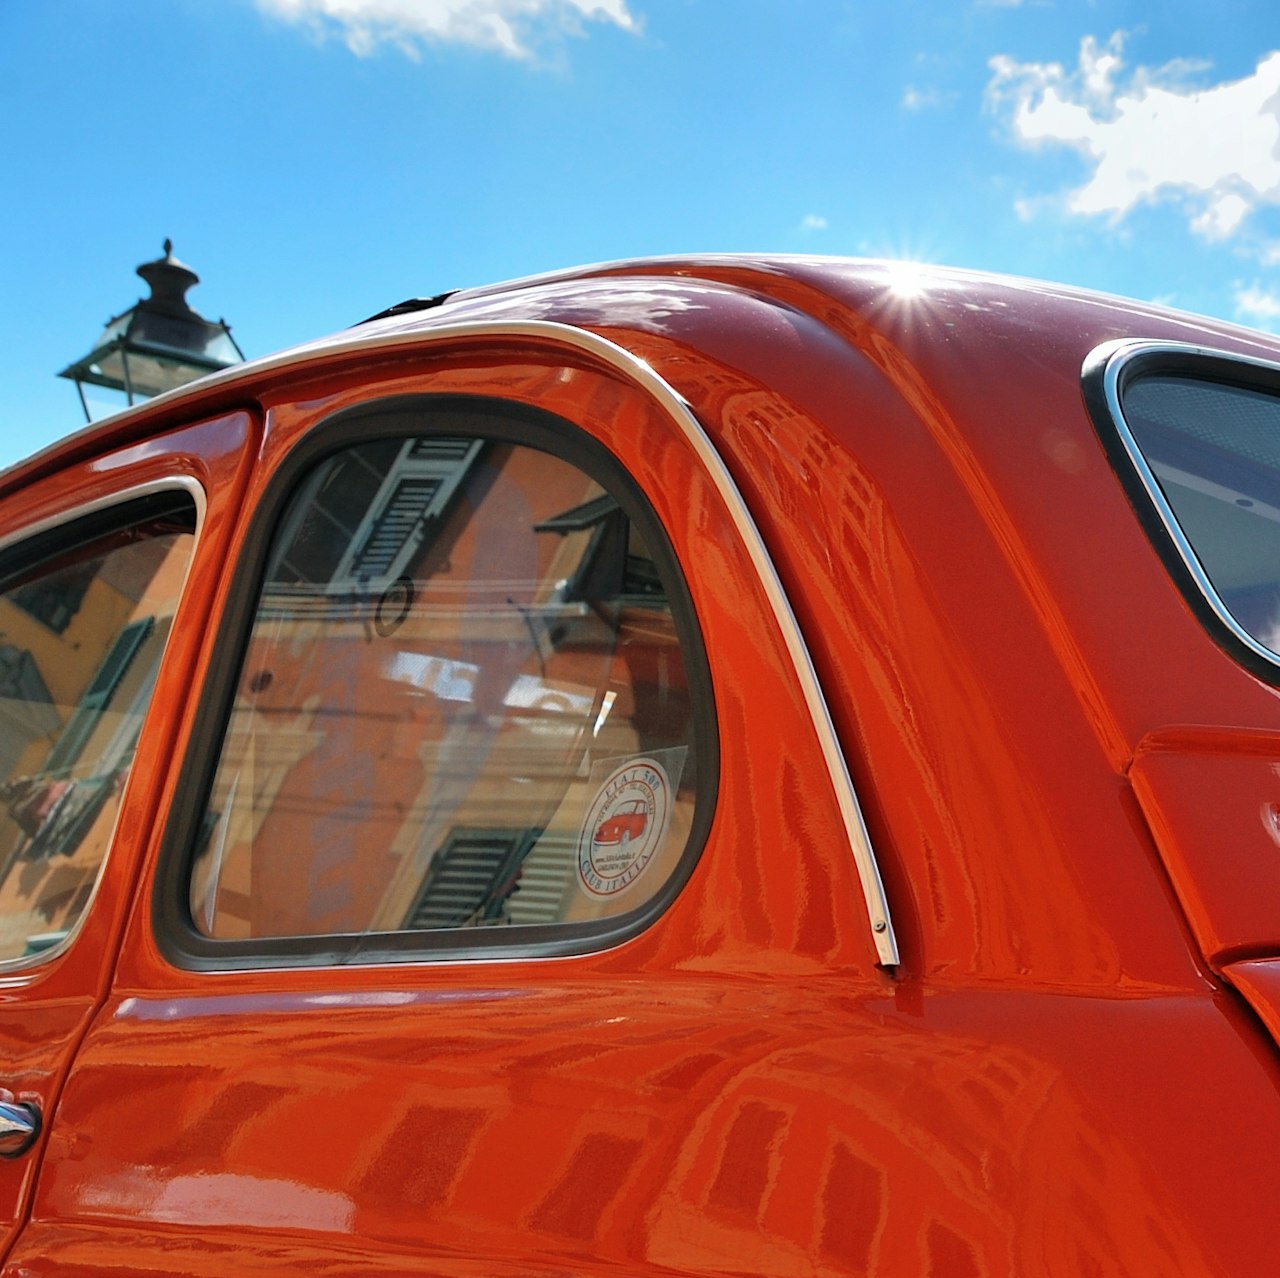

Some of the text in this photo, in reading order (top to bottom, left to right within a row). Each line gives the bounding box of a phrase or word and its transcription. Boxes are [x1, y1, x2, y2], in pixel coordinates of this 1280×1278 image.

[605, 770, 661, 798] FIAT 500
[582, 854, 649, 891] CLUB ITALIA
